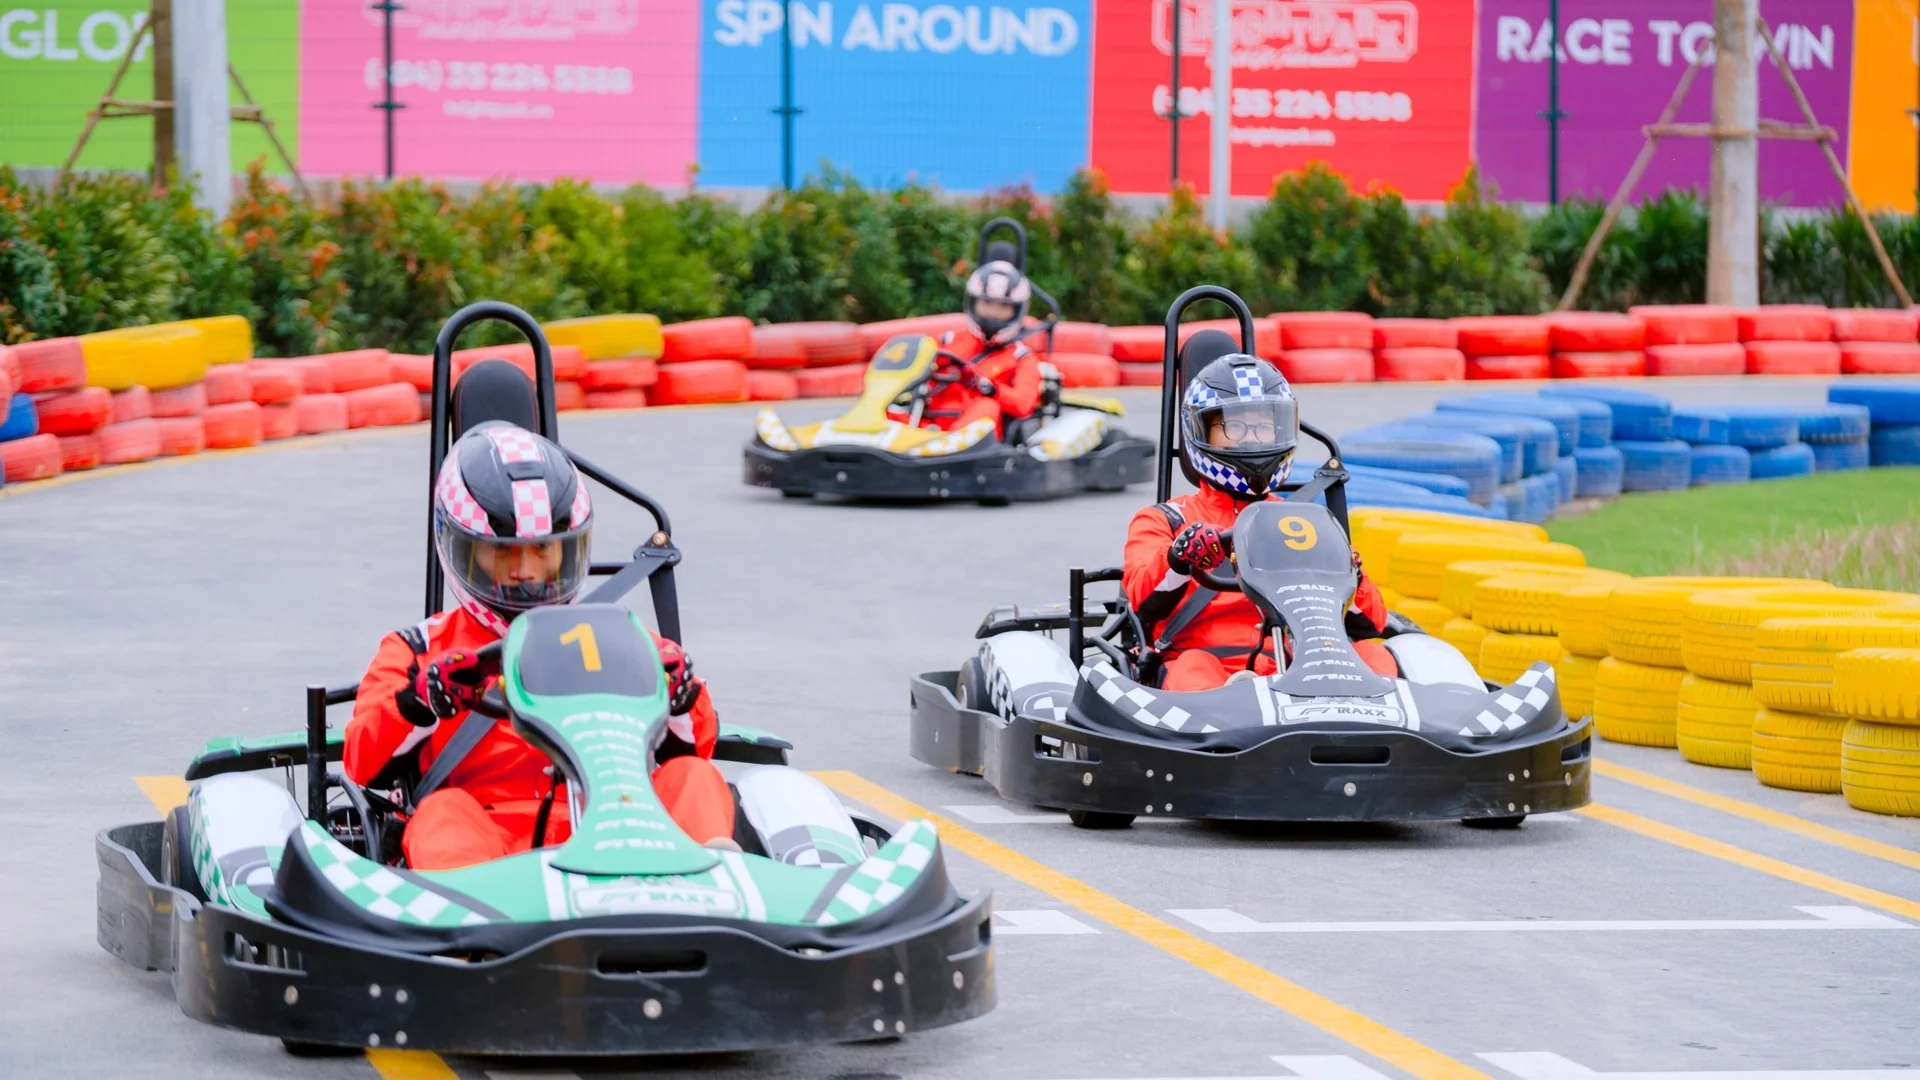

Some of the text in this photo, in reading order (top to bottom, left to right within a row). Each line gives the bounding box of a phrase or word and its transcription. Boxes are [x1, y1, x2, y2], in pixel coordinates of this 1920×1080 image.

[713, 0, 1079, 56] SPN AROUND
[1497, 15, 1634, 65] RACE
[1278, 516, 1318, 551] 9
[1298, 584, 1335, 593] TRAXX
[560, 623, 602, 672] 1
[1322, 659, 1356, 668] TRAXX
[1325, 673, 1364, 682] TRAXX
[1333, 706, 1387, 718] TRAXX
[647, 890, 716, 906] TRAXX
